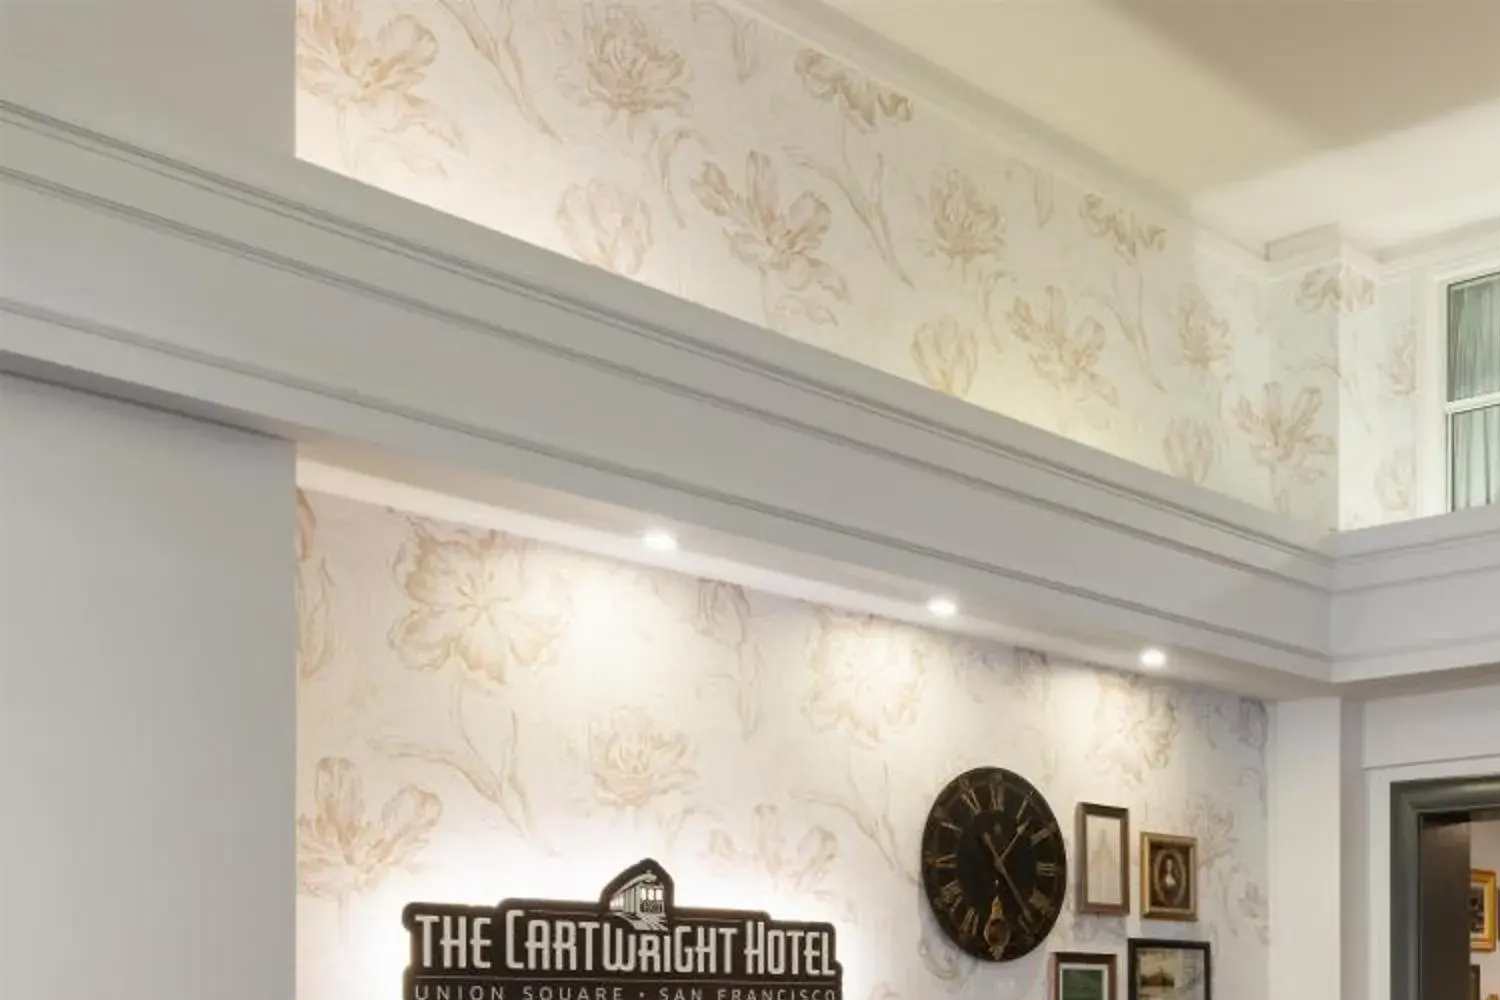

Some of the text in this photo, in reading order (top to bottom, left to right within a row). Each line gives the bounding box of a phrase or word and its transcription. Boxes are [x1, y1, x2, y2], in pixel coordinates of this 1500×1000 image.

[415, 909, 836, 977] THE CARTWRIGHT HOTEL
